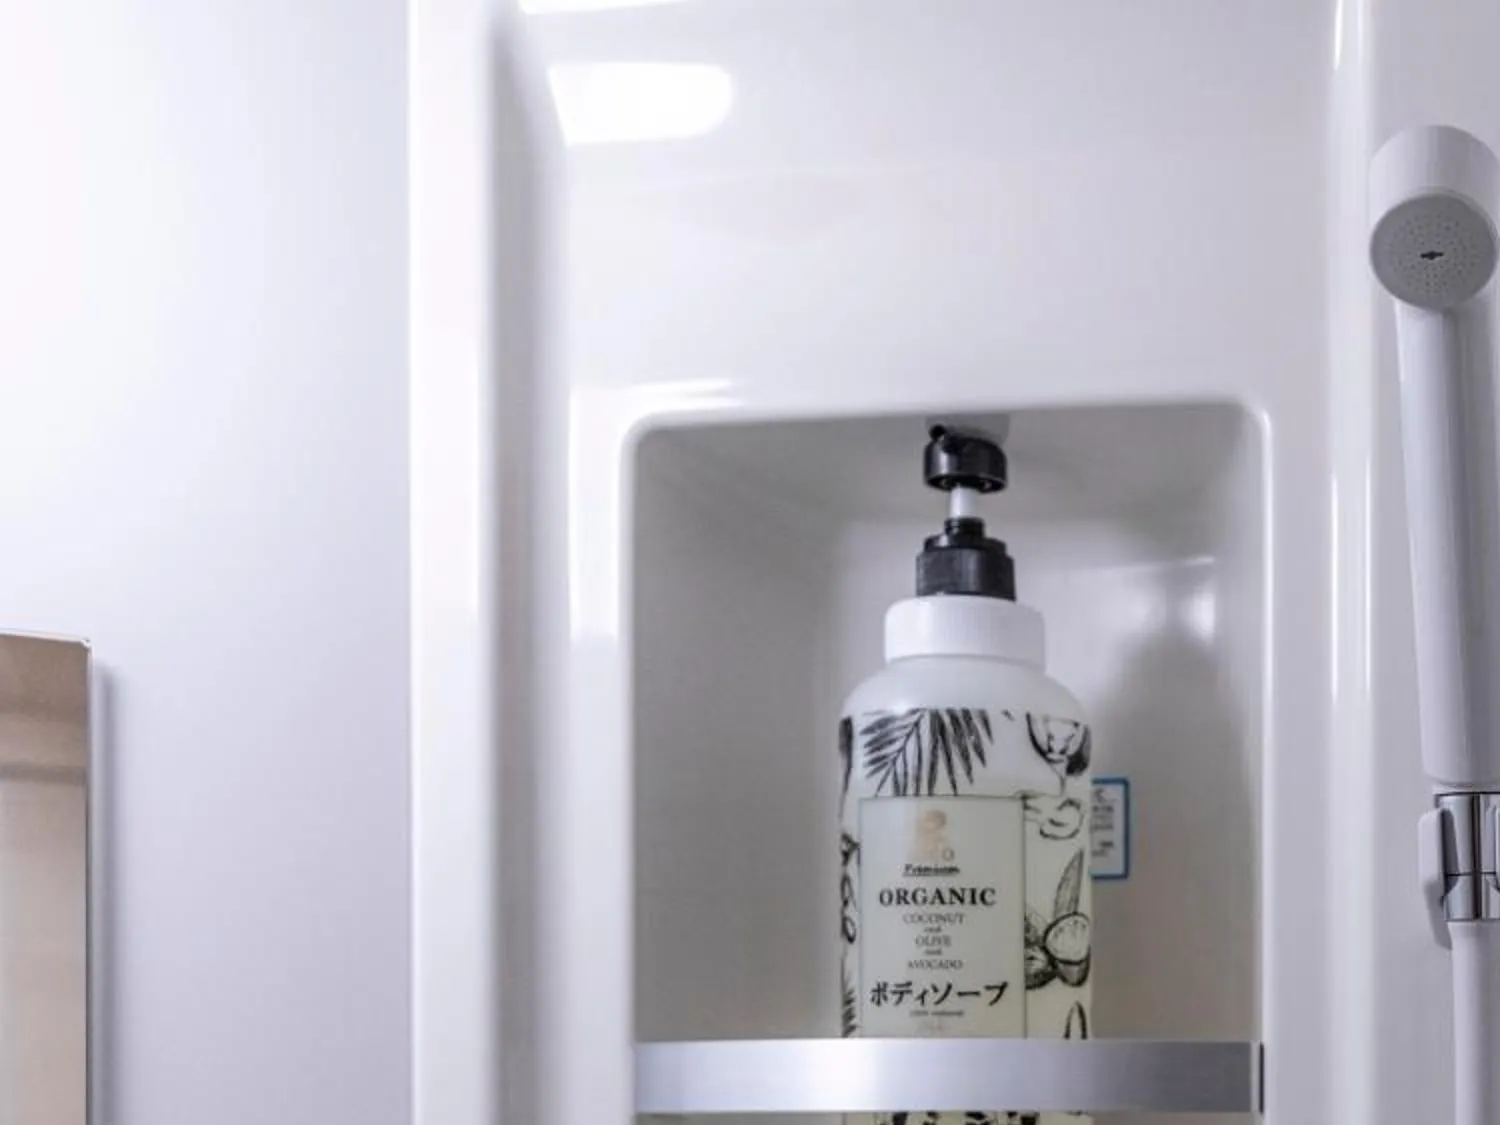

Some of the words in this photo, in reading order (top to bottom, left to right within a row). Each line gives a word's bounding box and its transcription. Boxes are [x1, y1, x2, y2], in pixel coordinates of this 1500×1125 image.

[879, 887, 996, 906] ORGANIC
[908, 959, 964, 970] AVOCADO
[870, 981, 1009, 1006] ボディソープ
